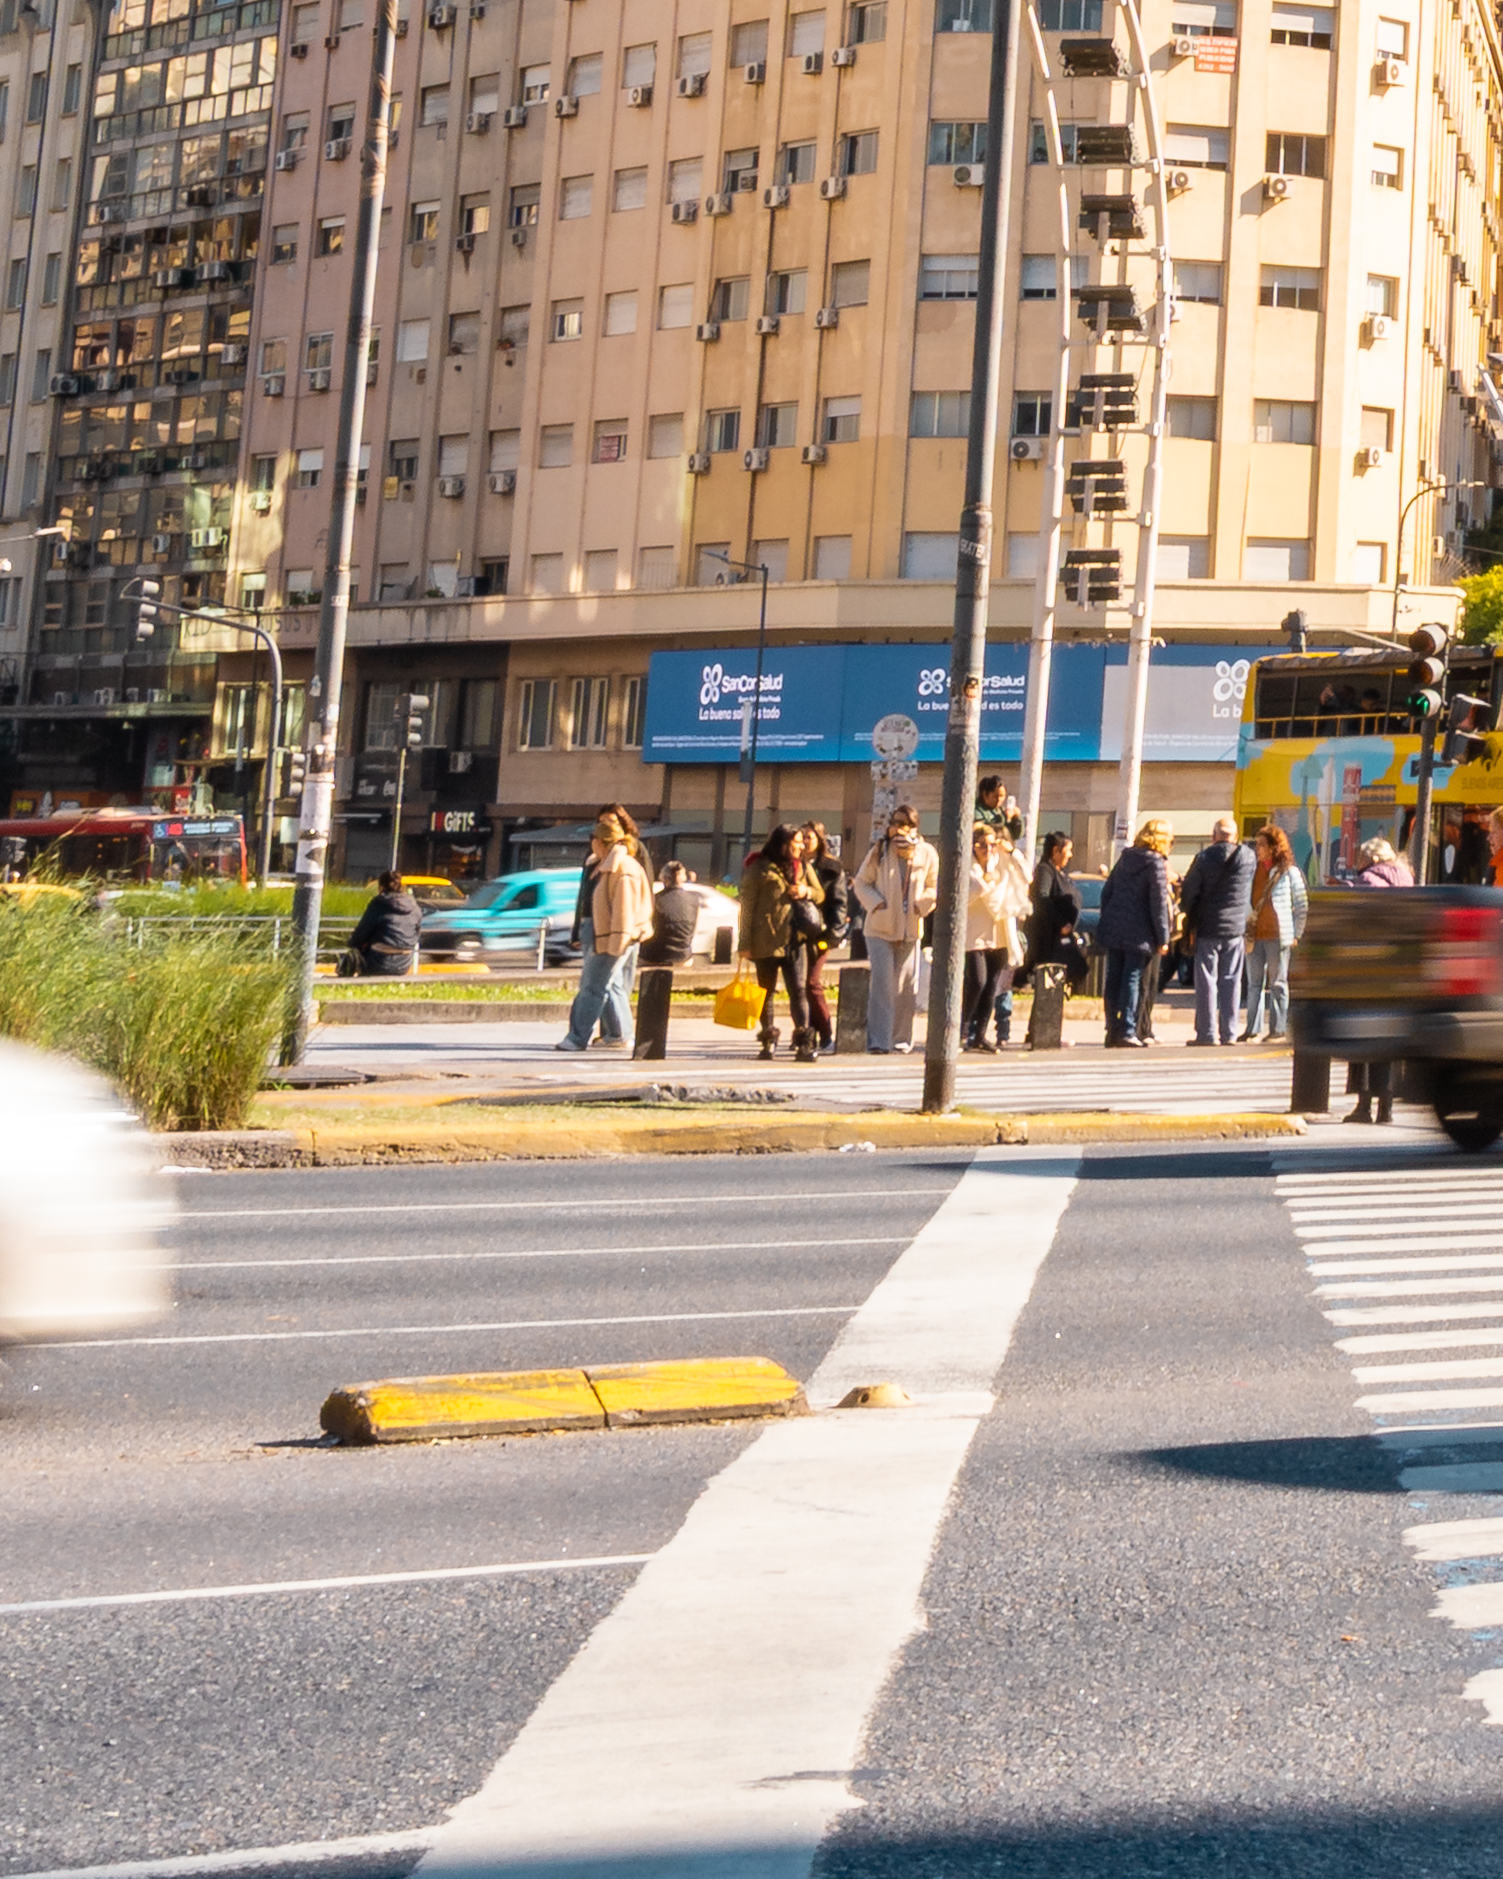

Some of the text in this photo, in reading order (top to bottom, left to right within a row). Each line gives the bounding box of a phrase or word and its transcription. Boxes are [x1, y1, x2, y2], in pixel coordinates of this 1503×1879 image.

[917, 700, 930, 711] La
[1001, 699, 1024, 711] todo
[1213, 703, 1230, 718] La
